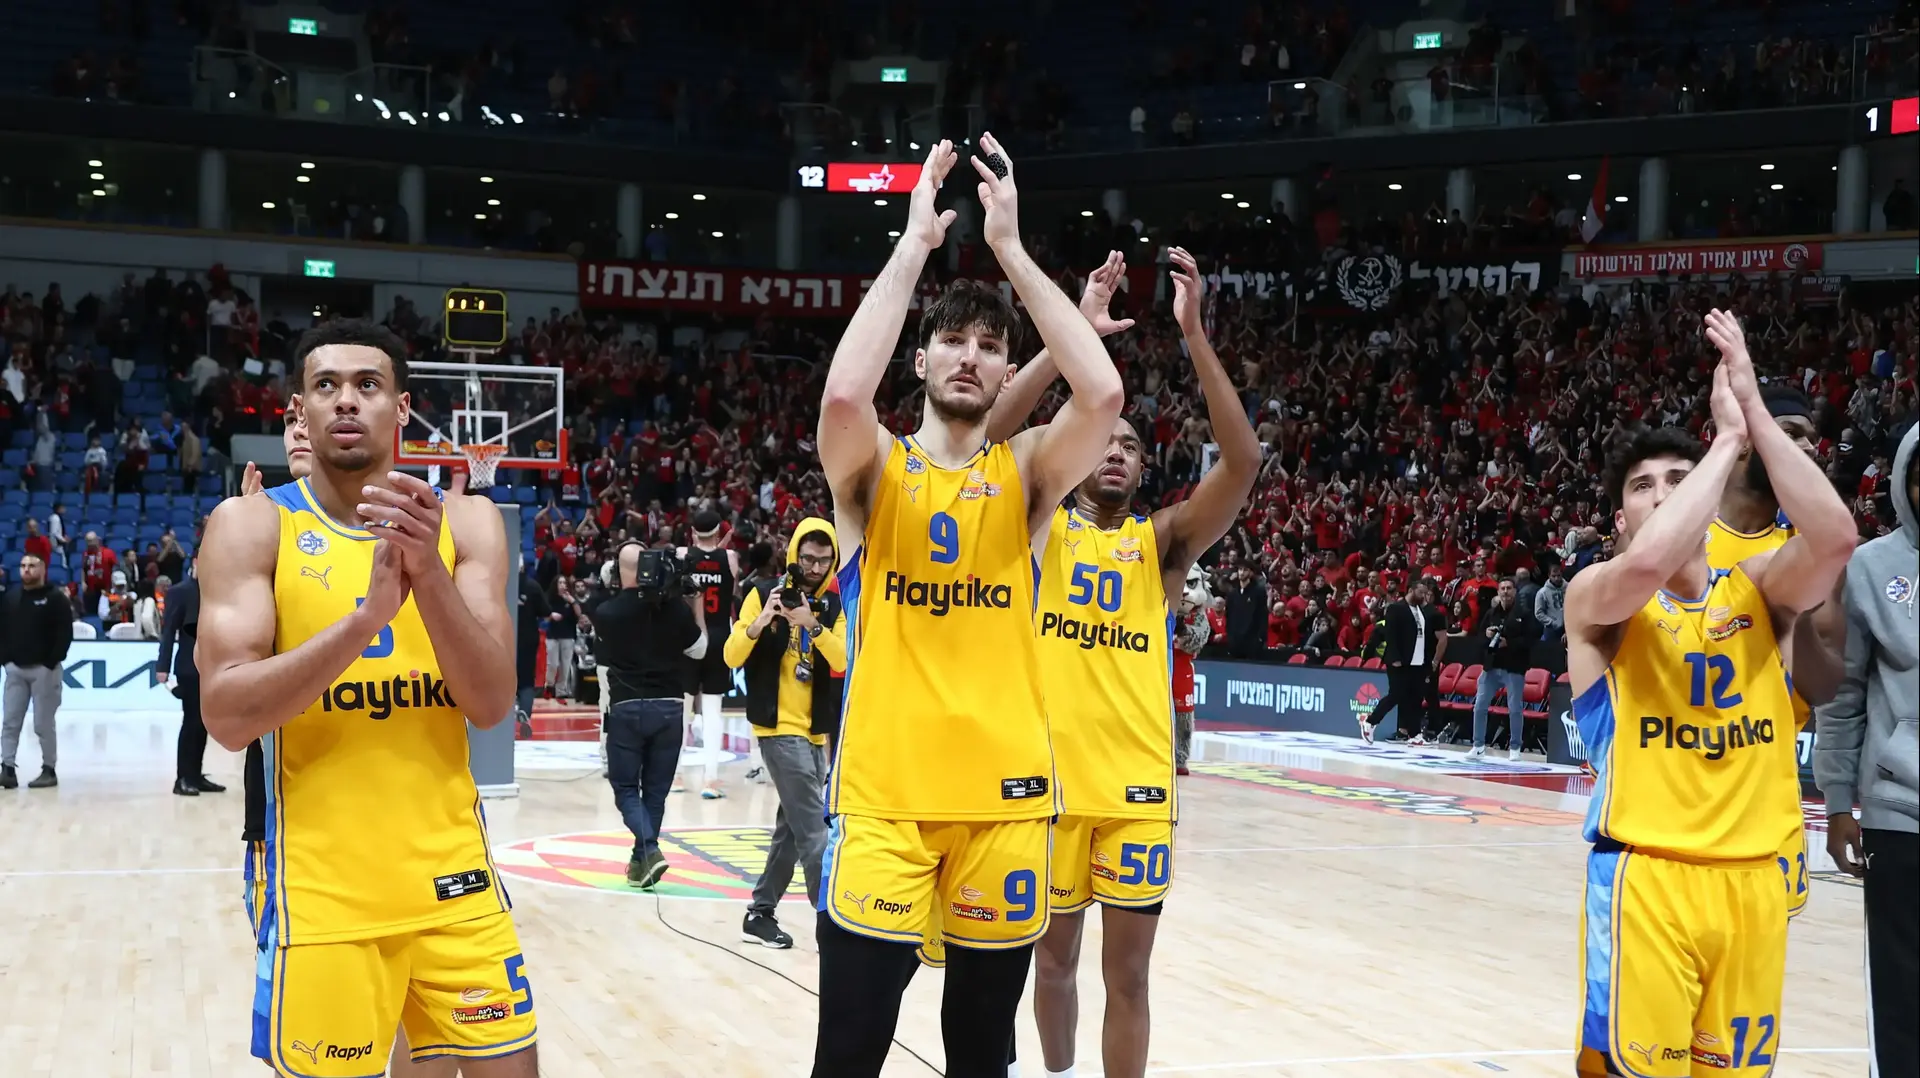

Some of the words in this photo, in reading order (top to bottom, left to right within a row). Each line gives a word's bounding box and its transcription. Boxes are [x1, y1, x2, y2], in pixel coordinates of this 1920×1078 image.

[798, 165, 825, 188] 12
[1648, 252, 1693, 271] ואלעד
[1700, 251, 1736, 269] אמיר
[1740, 249, 1774, 268] יציע
[586, 264, 724, 302] תנצח!
[740, 275, 843, 309] והיא
[929, 511, 960, 565] 9
[885, 571, 1012, 617] Playtika
[1067, 562, 1123, 613] 50
[1041, 612, 1150, 653] Playtika
[316, 669, 458, 720] laytik
[1226, 679, 1274, 708] המצטיין
[1683, 652, 1743, 709] 12
[1276, 684, 1325, 714] השחקן
[1029, 779, 1039, 788] XL
[1150, 788, 1160, 796] XL
[467, 873, 477, 884] M
[1118, 843, 1170, 886] 50
[873, 898, 913, 915] Rapyd
[1003, 869, 1036, 922] 9
[953, 906, 984, 919] Winner
[504, 953, 533, 1016] 5
[456, 1012, 493, 1022] Winner
[325, 1041, 373, 1061] Rapyd
[1730, 1014, 1775, 1069] 12
